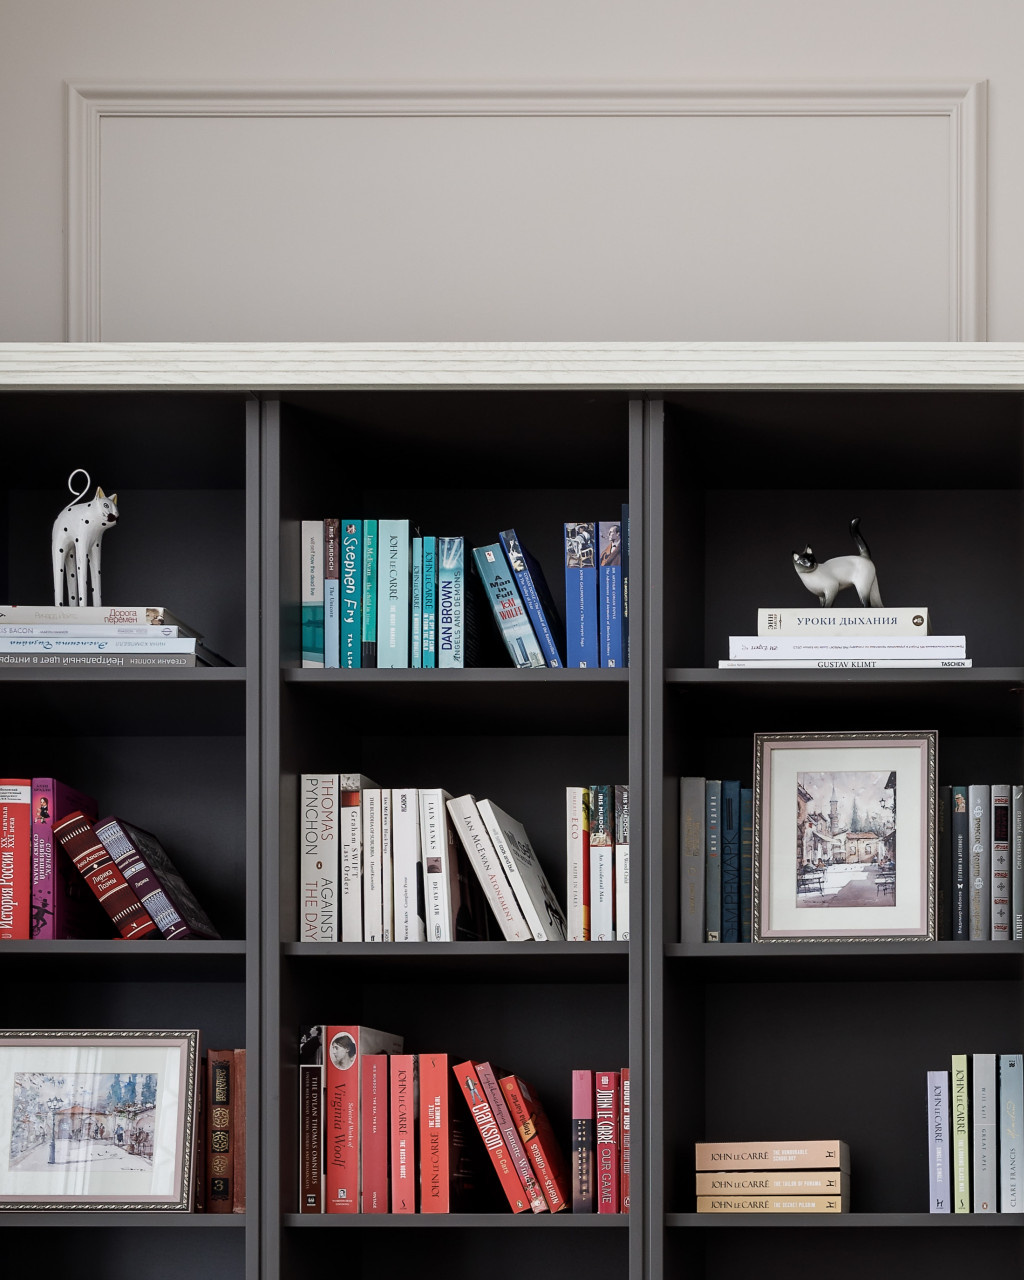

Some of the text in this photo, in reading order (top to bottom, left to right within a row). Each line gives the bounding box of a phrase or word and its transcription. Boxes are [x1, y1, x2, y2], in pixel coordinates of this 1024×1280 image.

[389, 535, 398, 560] JOHN
[425, 552, 434, 574] JOHN
[344, 536, 358, 623] Stephen Fry
[389, 570, 398, 600] CARRÉ
[425, 583, 434, 610] CARRÉ
[496, 590, 513, 600] Full
[104, 616, 138, 624] перемен
[110, 608, 137, 618] Дорога
[442, 580, 452, 650] DAN BROWN
[797, 617, 898, 627] УРОКИ ДЫХАНИЯ
[40, 656, 60, 664] цвет
[63, 656, 124, 666] Нейтральный
[305, 778, 318, 854] PYNCHON
[321, 778, 334, 840] THOMAS
[92, 870, 113, 884] Лирика
[463, 816, 514, 922] IAN McEWAN ATONEMENT
[723, 832, 738, 904] РЕМАРК
[0, 852, 18, 928] История России
[98, 878, 117, 892] Поэмы
[305, 881, 318, 941] THE DAY
[320, 878, 333, 941] AGAINST
[398, 1070, 407, 1094] JOHN
[956, 1069, 964, 1094] JOHN
[597, 1089, 614, 1108] JOHN
[934, 1086, 942, 1106] JOHN
[331, 1083, 346, 1169] Virginia Woolf
[398, 1103, 408, 1134] CARRÉ
[510, 1093, 533, 1136] Angela Carter
[956, 1103, 966, 1134] CARRÉ
[472, 1102, 510, 1174] Clarkson On Cars
[597, 1121, 616, 1144] CARRÉ
[935, 1116, 944, 1142] CARRÉ
[431, 1133, 440, 1162] CARRÉ
[602, 1148, 611, 1170] OUR
[741, 1152, 768, 1160] CARRÉ
[504, 1127, 521, 1158] Jeanette
[518, 1158, 538, 1198] Winterson
[431, 1174, 440, 1198] JOHN
[544, 1180, 560, 1204] NIGHTS
[602, 1174, 612, 1204] GAME
[742, 1180, 770, 1188] CARRÉ
[742, 1200, 769, 1208] CARRÉ
